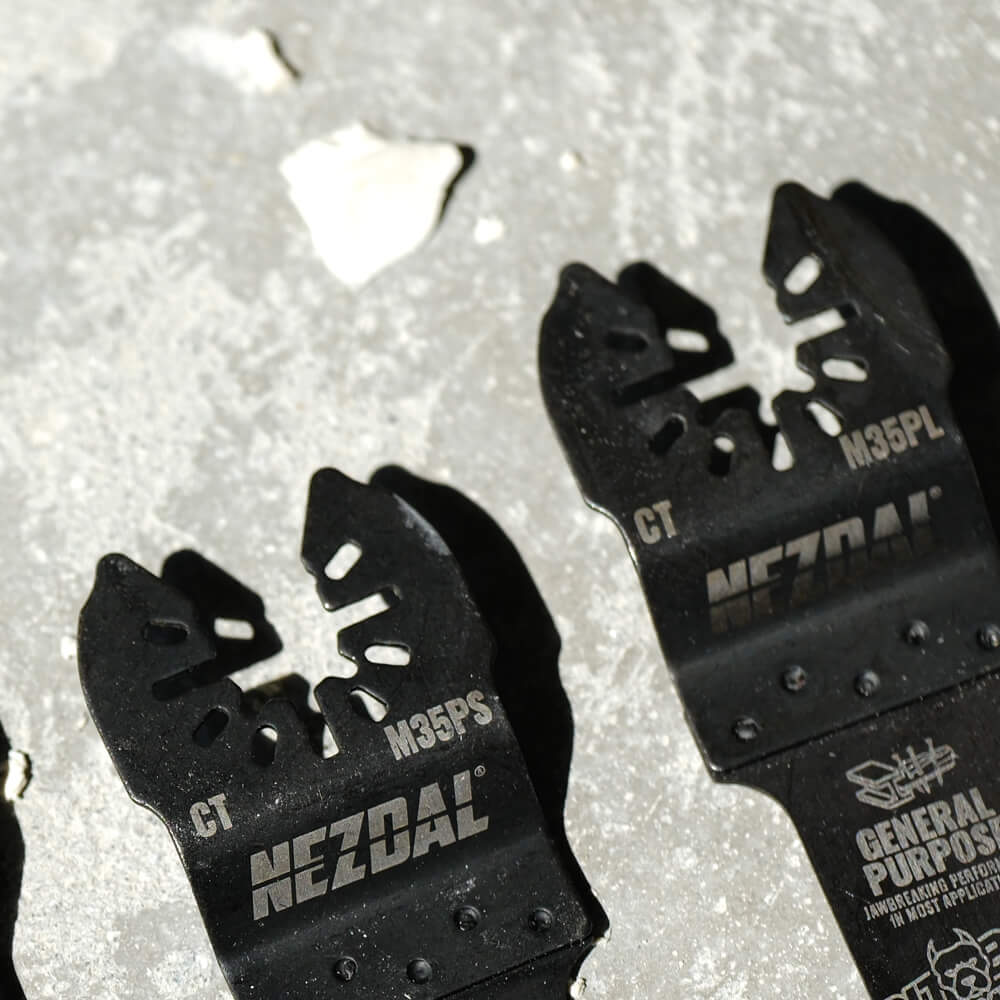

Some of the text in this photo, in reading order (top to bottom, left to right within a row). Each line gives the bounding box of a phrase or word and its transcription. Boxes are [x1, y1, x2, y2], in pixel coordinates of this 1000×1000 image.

[838, 405, 945, 470] M35PL
[633, 499, 677, 545] CT
[383, 689, 493, 761] M35PS
[189, 793, 233, 838] CT
[855, 787, 997, 862] GENERAL
[863, 878, 949, 921] JAWBREAKING
[889, 911, 905, 929] IN
[905, 897, 941, 923] MOST
